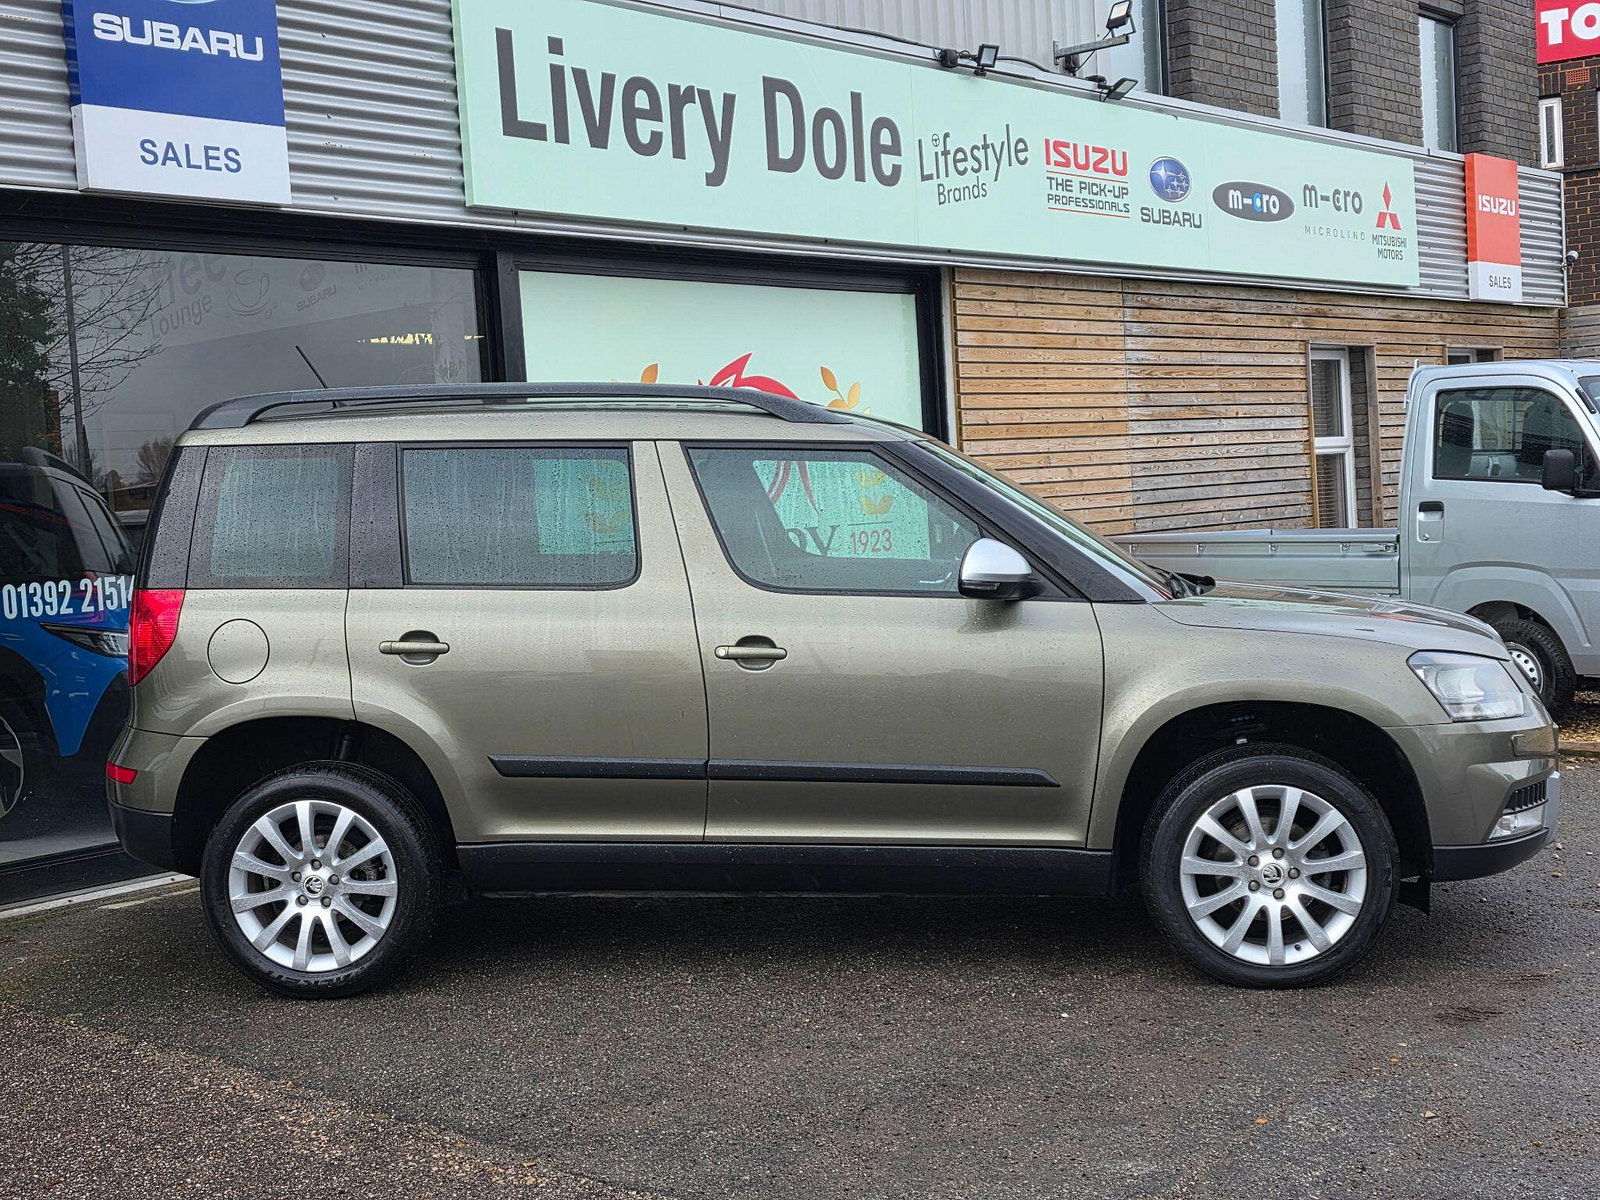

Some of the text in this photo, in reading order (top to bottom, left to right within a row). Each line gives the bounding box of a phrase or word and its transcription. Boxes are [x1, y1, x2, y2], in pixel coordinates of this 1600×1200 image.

[93, 12, 264, 62] SUBARU
[495, 26, 902, 187] Livery Dole
[139, 138, 242, 173] SALES
[918, 123, 1029, 181] Lifestyle
[1044, 138, 1128, 177] ISUZU
[937, 176, 988, 206] Brands
[1046, 176, 1129, 200] THE PICK-UP
[1047, 193, 1130, 214] PROFESSIONALS
[1478, 194, 1516, 217] ISUZU
[1140, 206, 1203, 229] SUBARU
[1304, 225, 1366, 241] MICROLINO
[1371, 234, 1408, 249] MITSUBISHI
[1377, 247, 1404, 261] MOTORS
[1489, 275, 1512, 290] SALES
[850, 528, 894, 554] 1923
[2, 579, 74, 620] 01392
